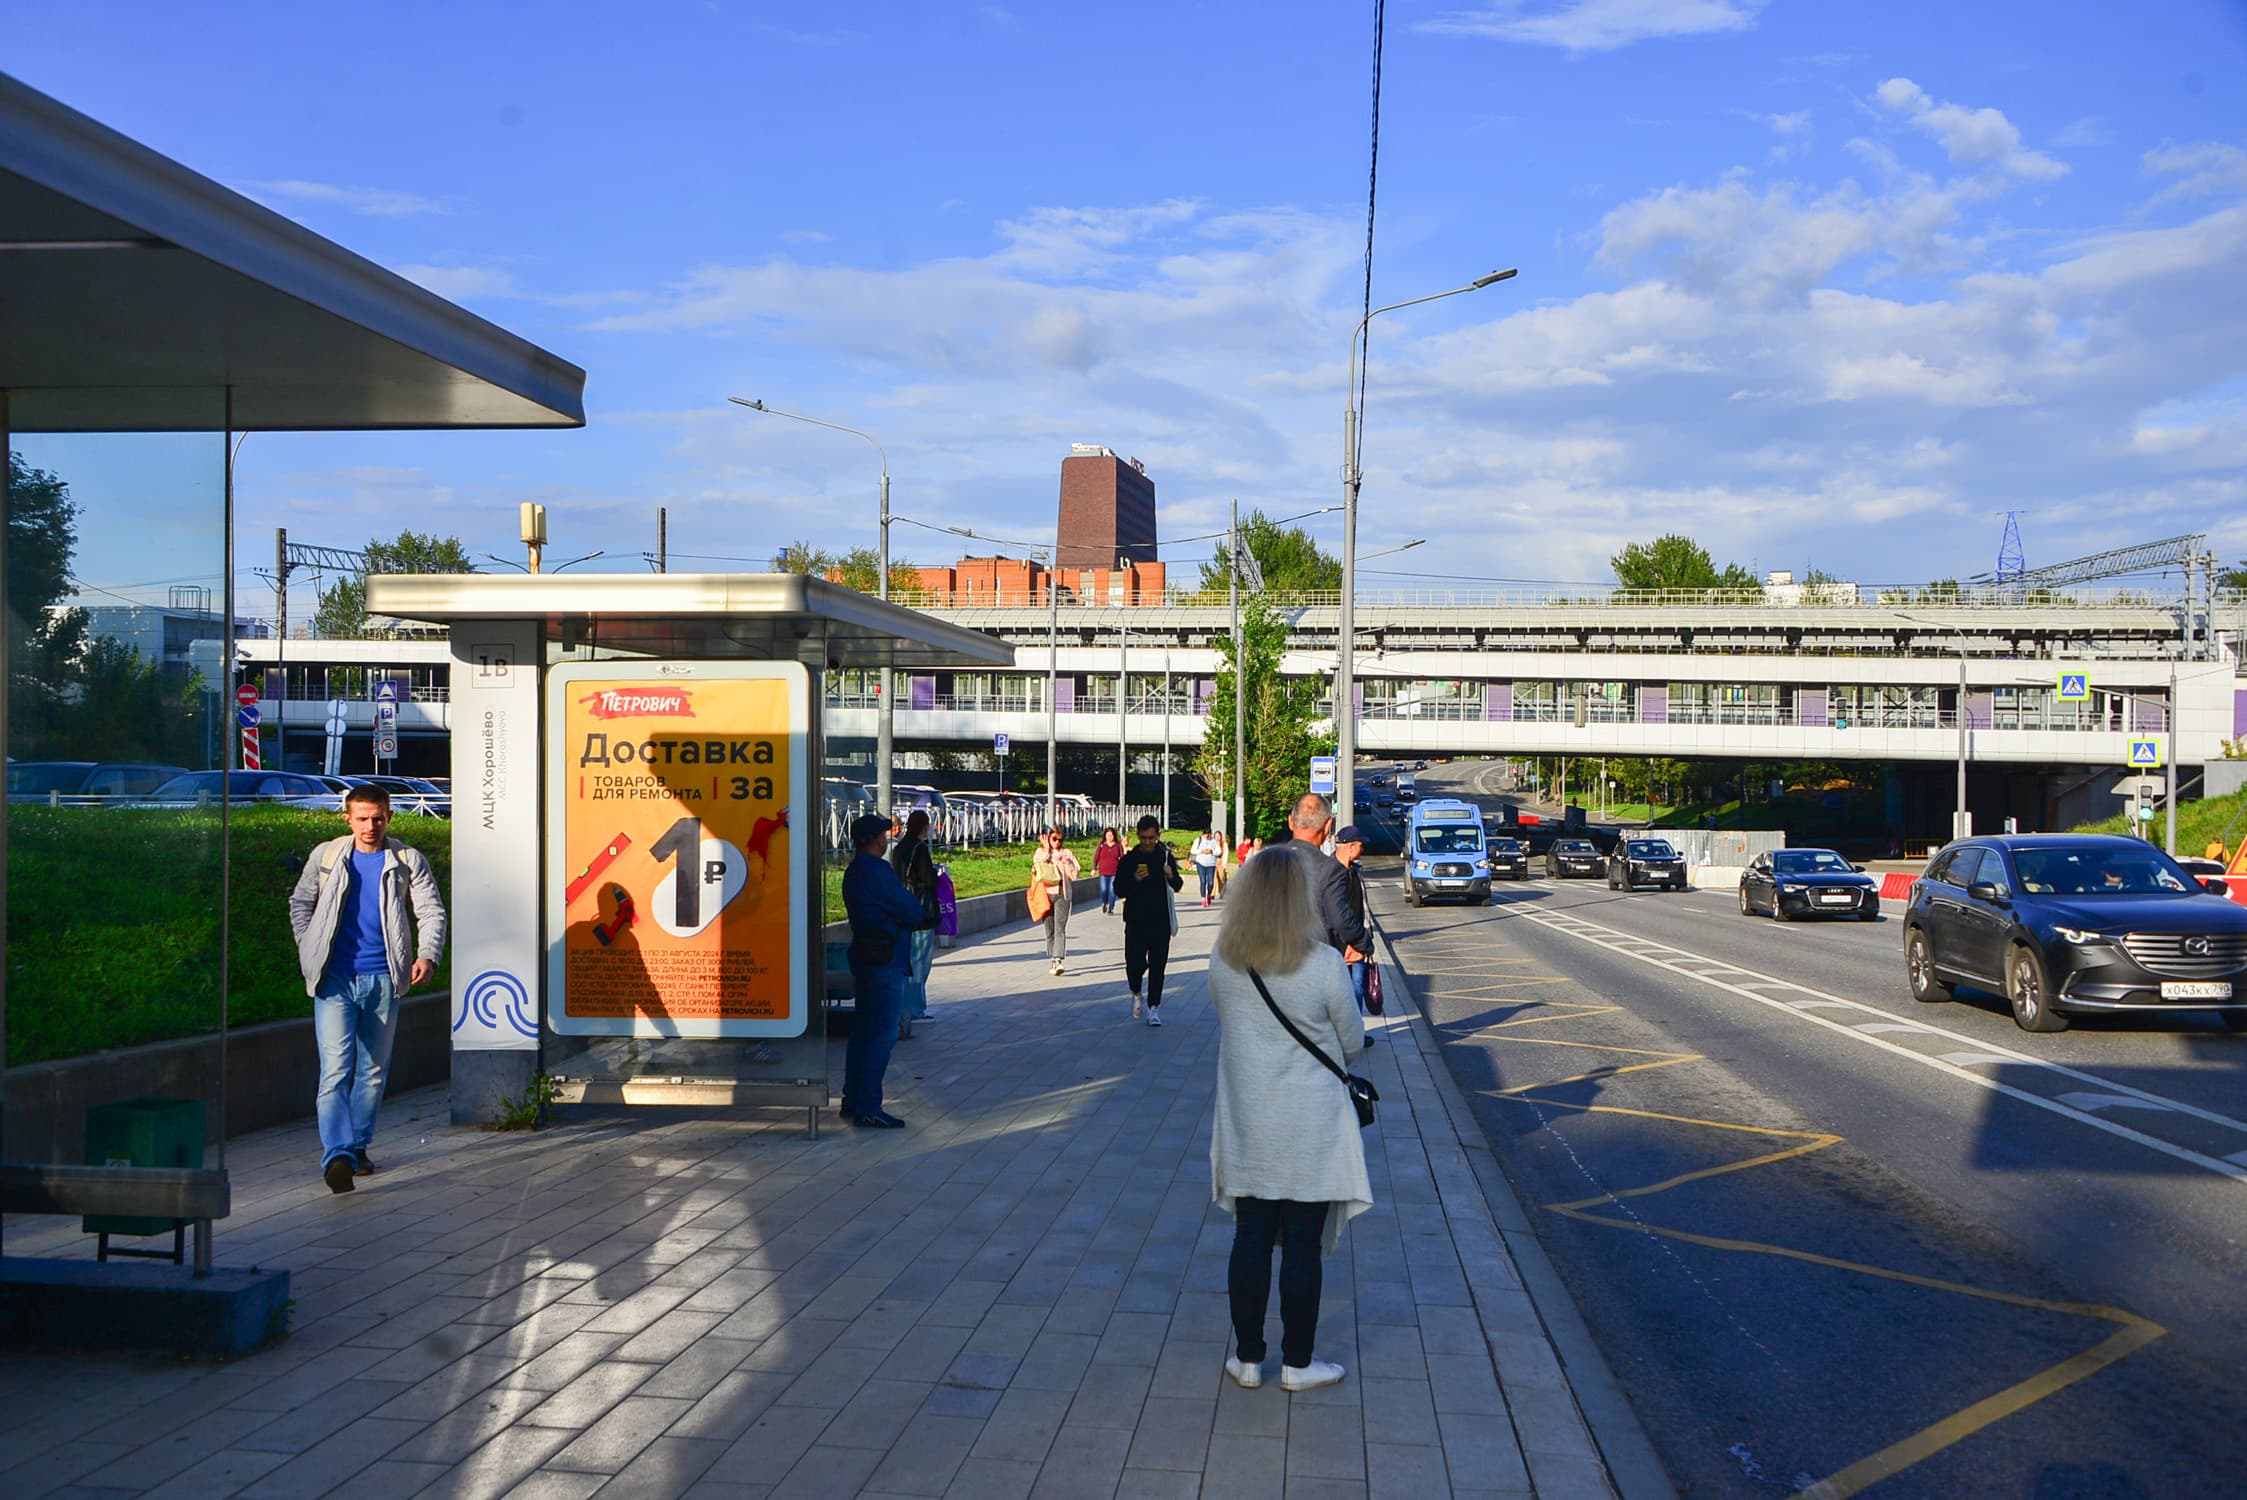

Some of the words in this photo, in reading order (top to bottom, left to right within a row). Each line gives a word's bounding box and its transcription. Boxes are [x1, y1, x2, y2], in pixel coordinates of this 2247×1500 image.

[482, 711, 496, 788] Хорошёво
[580, 733, 774, 768] Доставка
[594, 776, 666, 787] ТОВАРОВ
[729, 776, 774, 800] за
[592, 788, 624, 800] ДЛЯ
[629, 788, 702, 800] РЕМОНТА
[483, 791, 496, 831] МЦК
[721, 1007, 774, 1015] PETROVICH.RU
